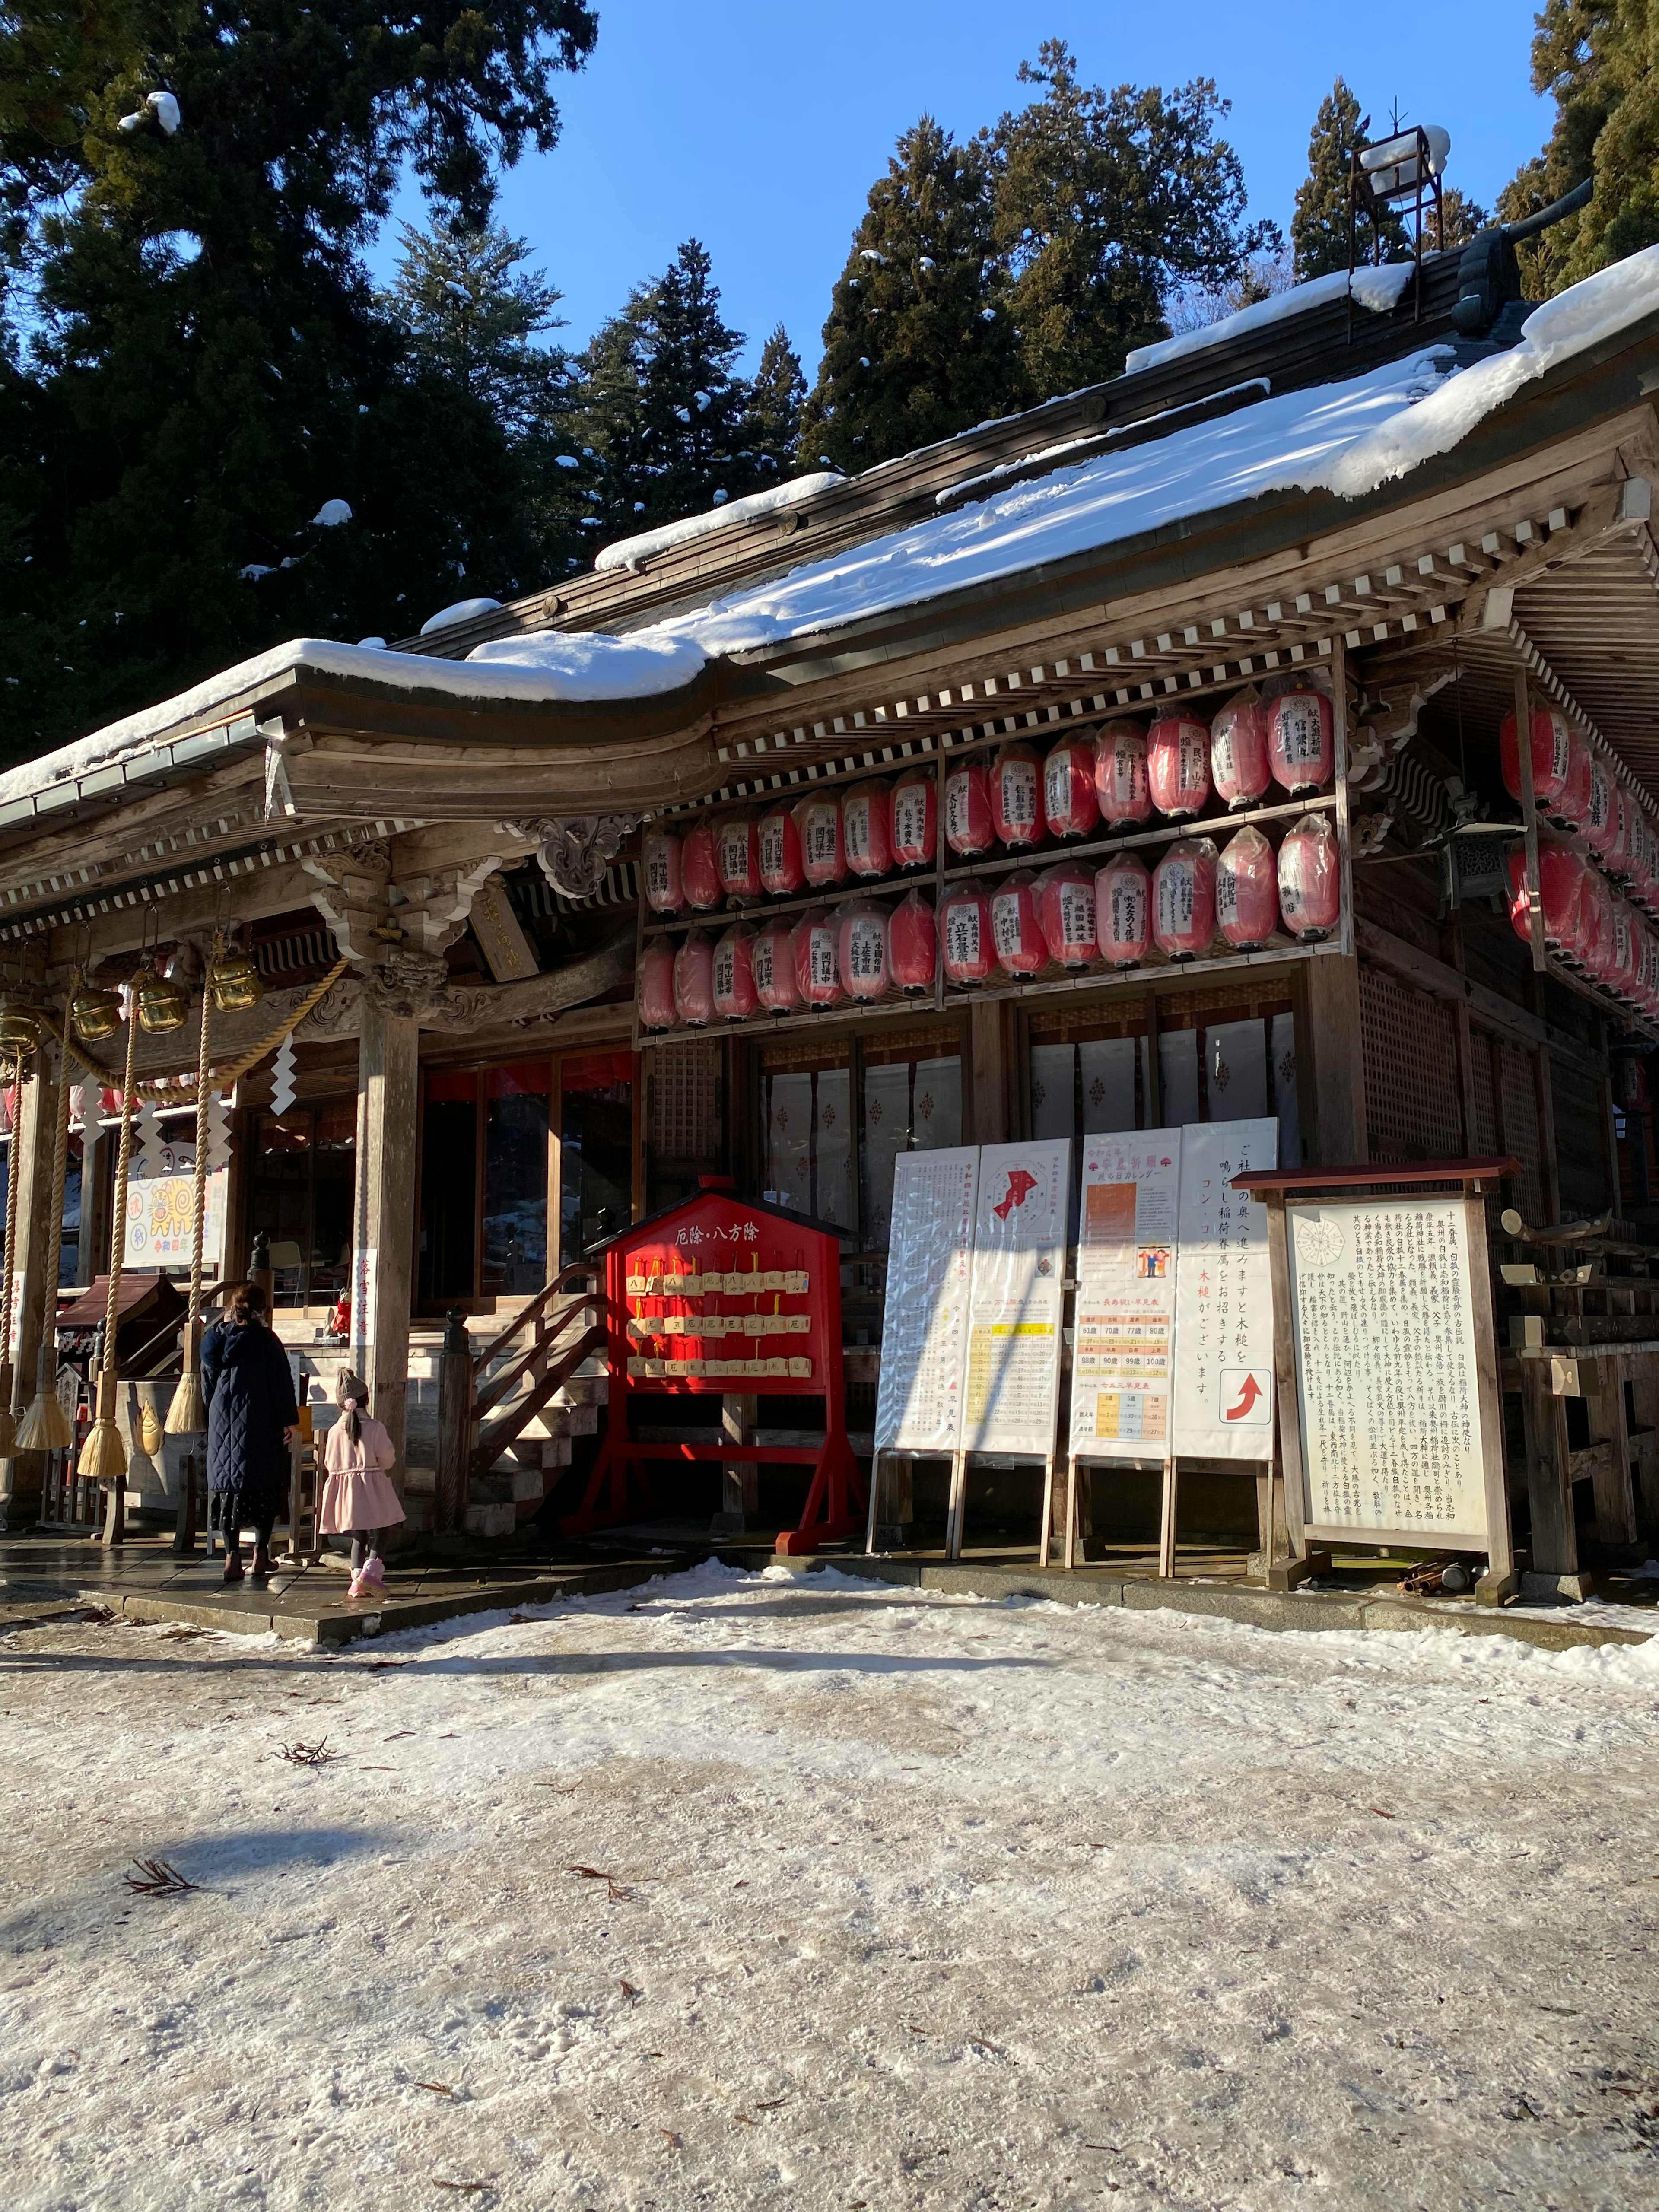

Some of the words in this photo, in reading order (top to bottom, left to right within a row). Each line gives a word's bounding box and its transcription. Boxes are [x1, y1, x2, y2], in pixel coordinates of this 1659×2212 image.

[1308, 709, 1319, 718] 献
[1180, 737, 1192, 747] 燈
[958, 785, 967, 794] 献
[967, 915, 979, 923] 献
[483, 898, 522, 978] 稲荷神
[674, 1221, 760, 1246] 厄除・八方除
[154, 1237, 188, 1254] 令和四年
[1235, 1144, 1252, 1363] ご社の奥へ進みますと木槌を
[358, 1259, 371, 1336] 落雪注意
